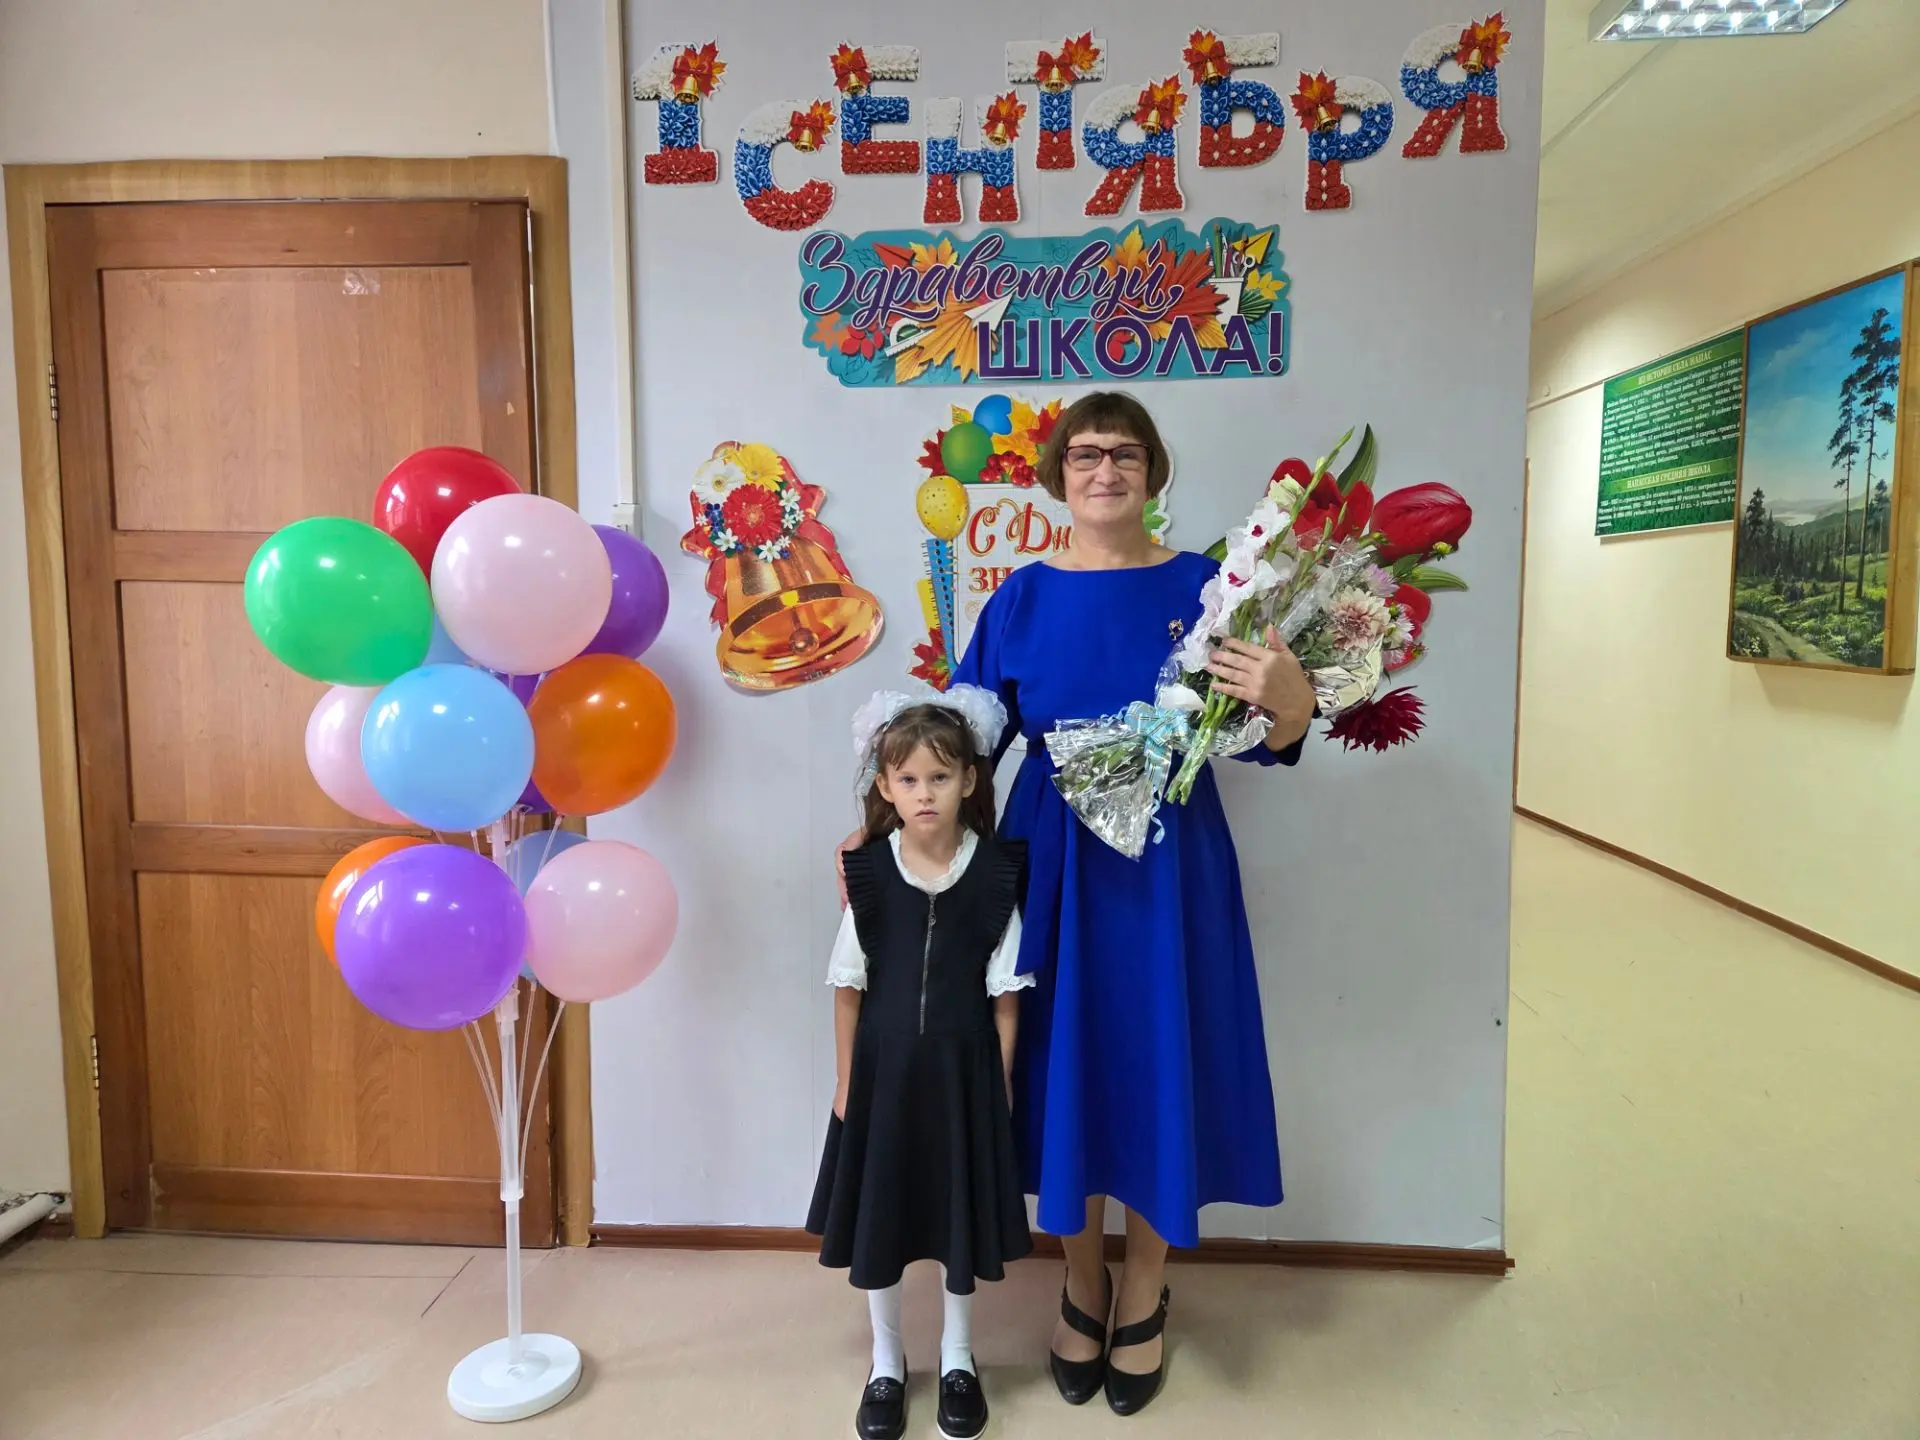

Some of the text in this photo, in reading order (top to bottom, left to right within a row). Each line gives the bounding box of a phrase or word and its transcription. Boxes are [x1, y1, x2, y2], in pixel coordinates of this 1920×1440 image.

[632, 20, 1507, 230] 1 СЕНТЯБРЯ
[802, 231, 1184, 330] Здравствуй,
[978, 311, 1283, 378] ШКОЛА!
[1672, 357, 1689, 371] СЕЛА
[1660, 467, 1688, 482] СРЕДНЯЯ
[1688, 463, 1712, 478] ШКОЛА
[967, 505, 1000, 557] С
